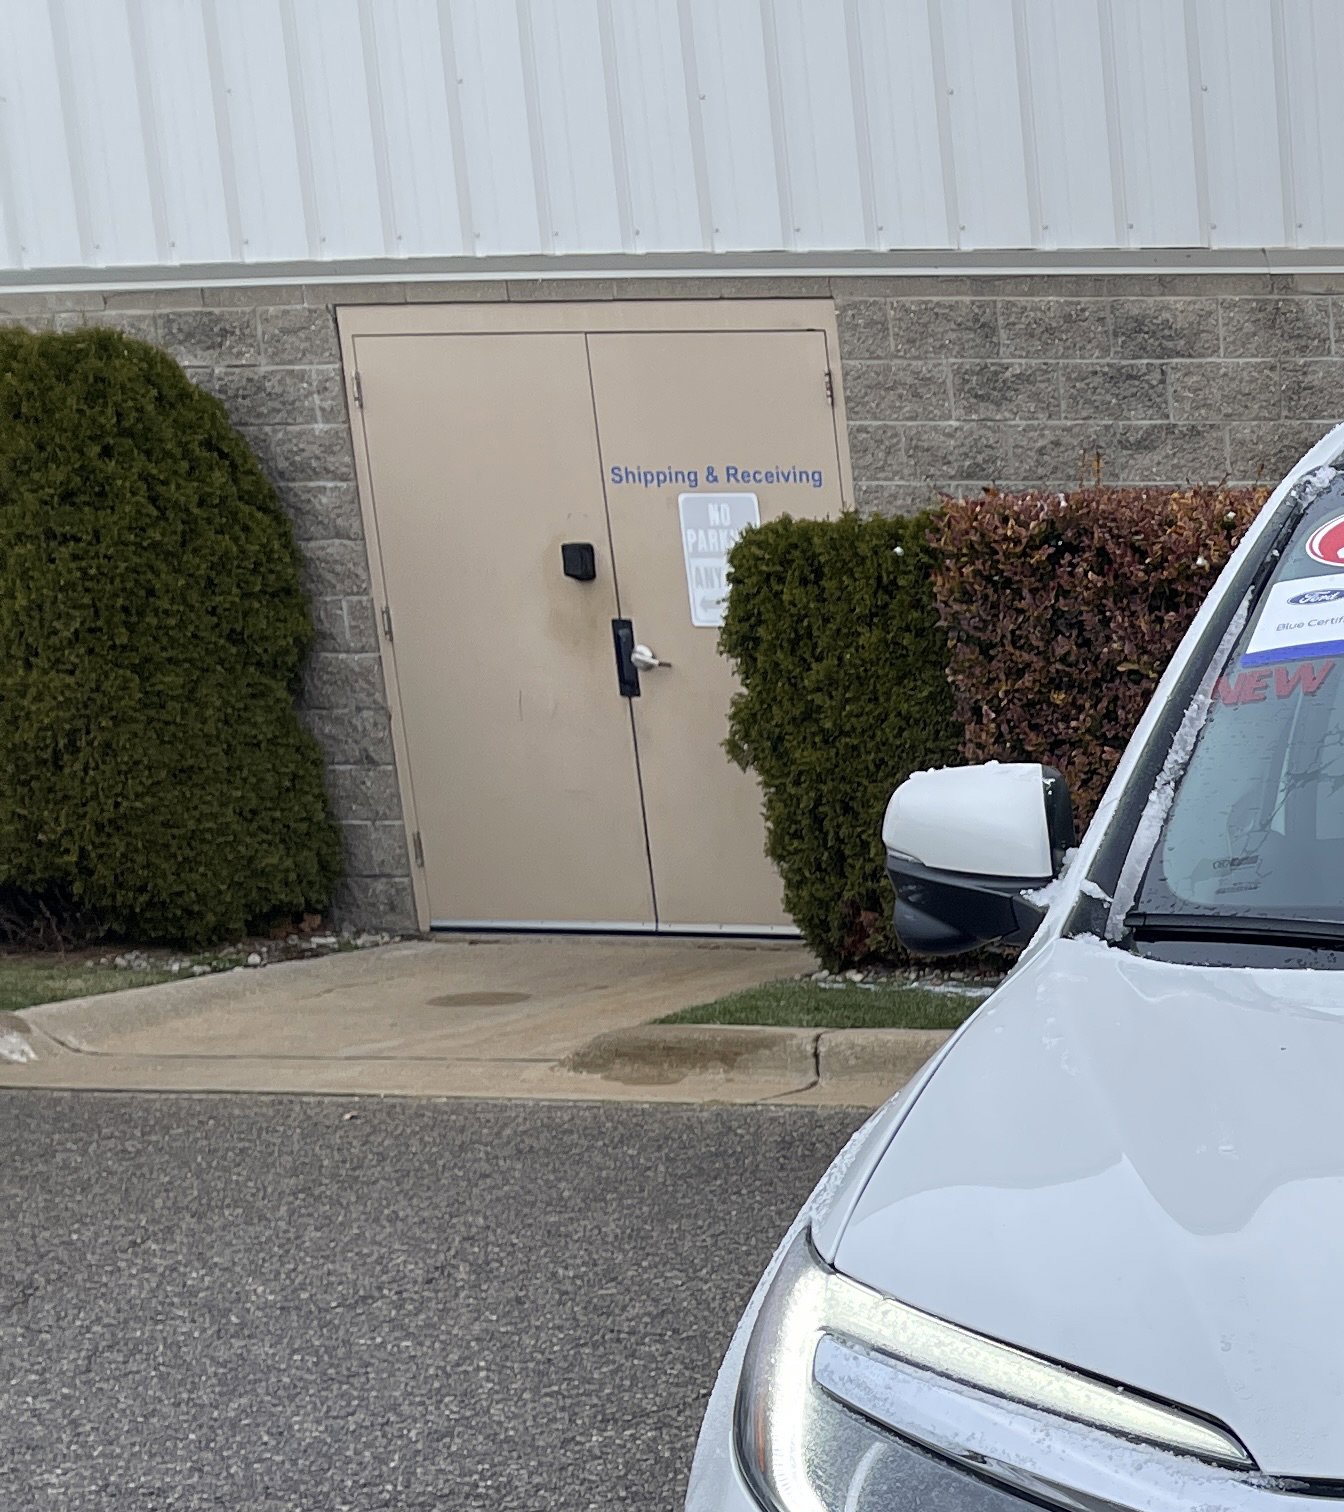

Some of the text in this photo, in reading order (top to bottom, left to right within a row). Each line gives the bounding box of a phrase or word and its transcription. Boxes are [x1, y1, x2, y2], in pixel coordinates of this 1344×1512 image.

[610, 465, 823, 488] Shipping & Receiving
[708, 503, 731, 526] NO
[686, 528, 737, 553] PARK
[1276, 622, 1305, 631] Blue
[1212, 660, 1336, 704] NEW
